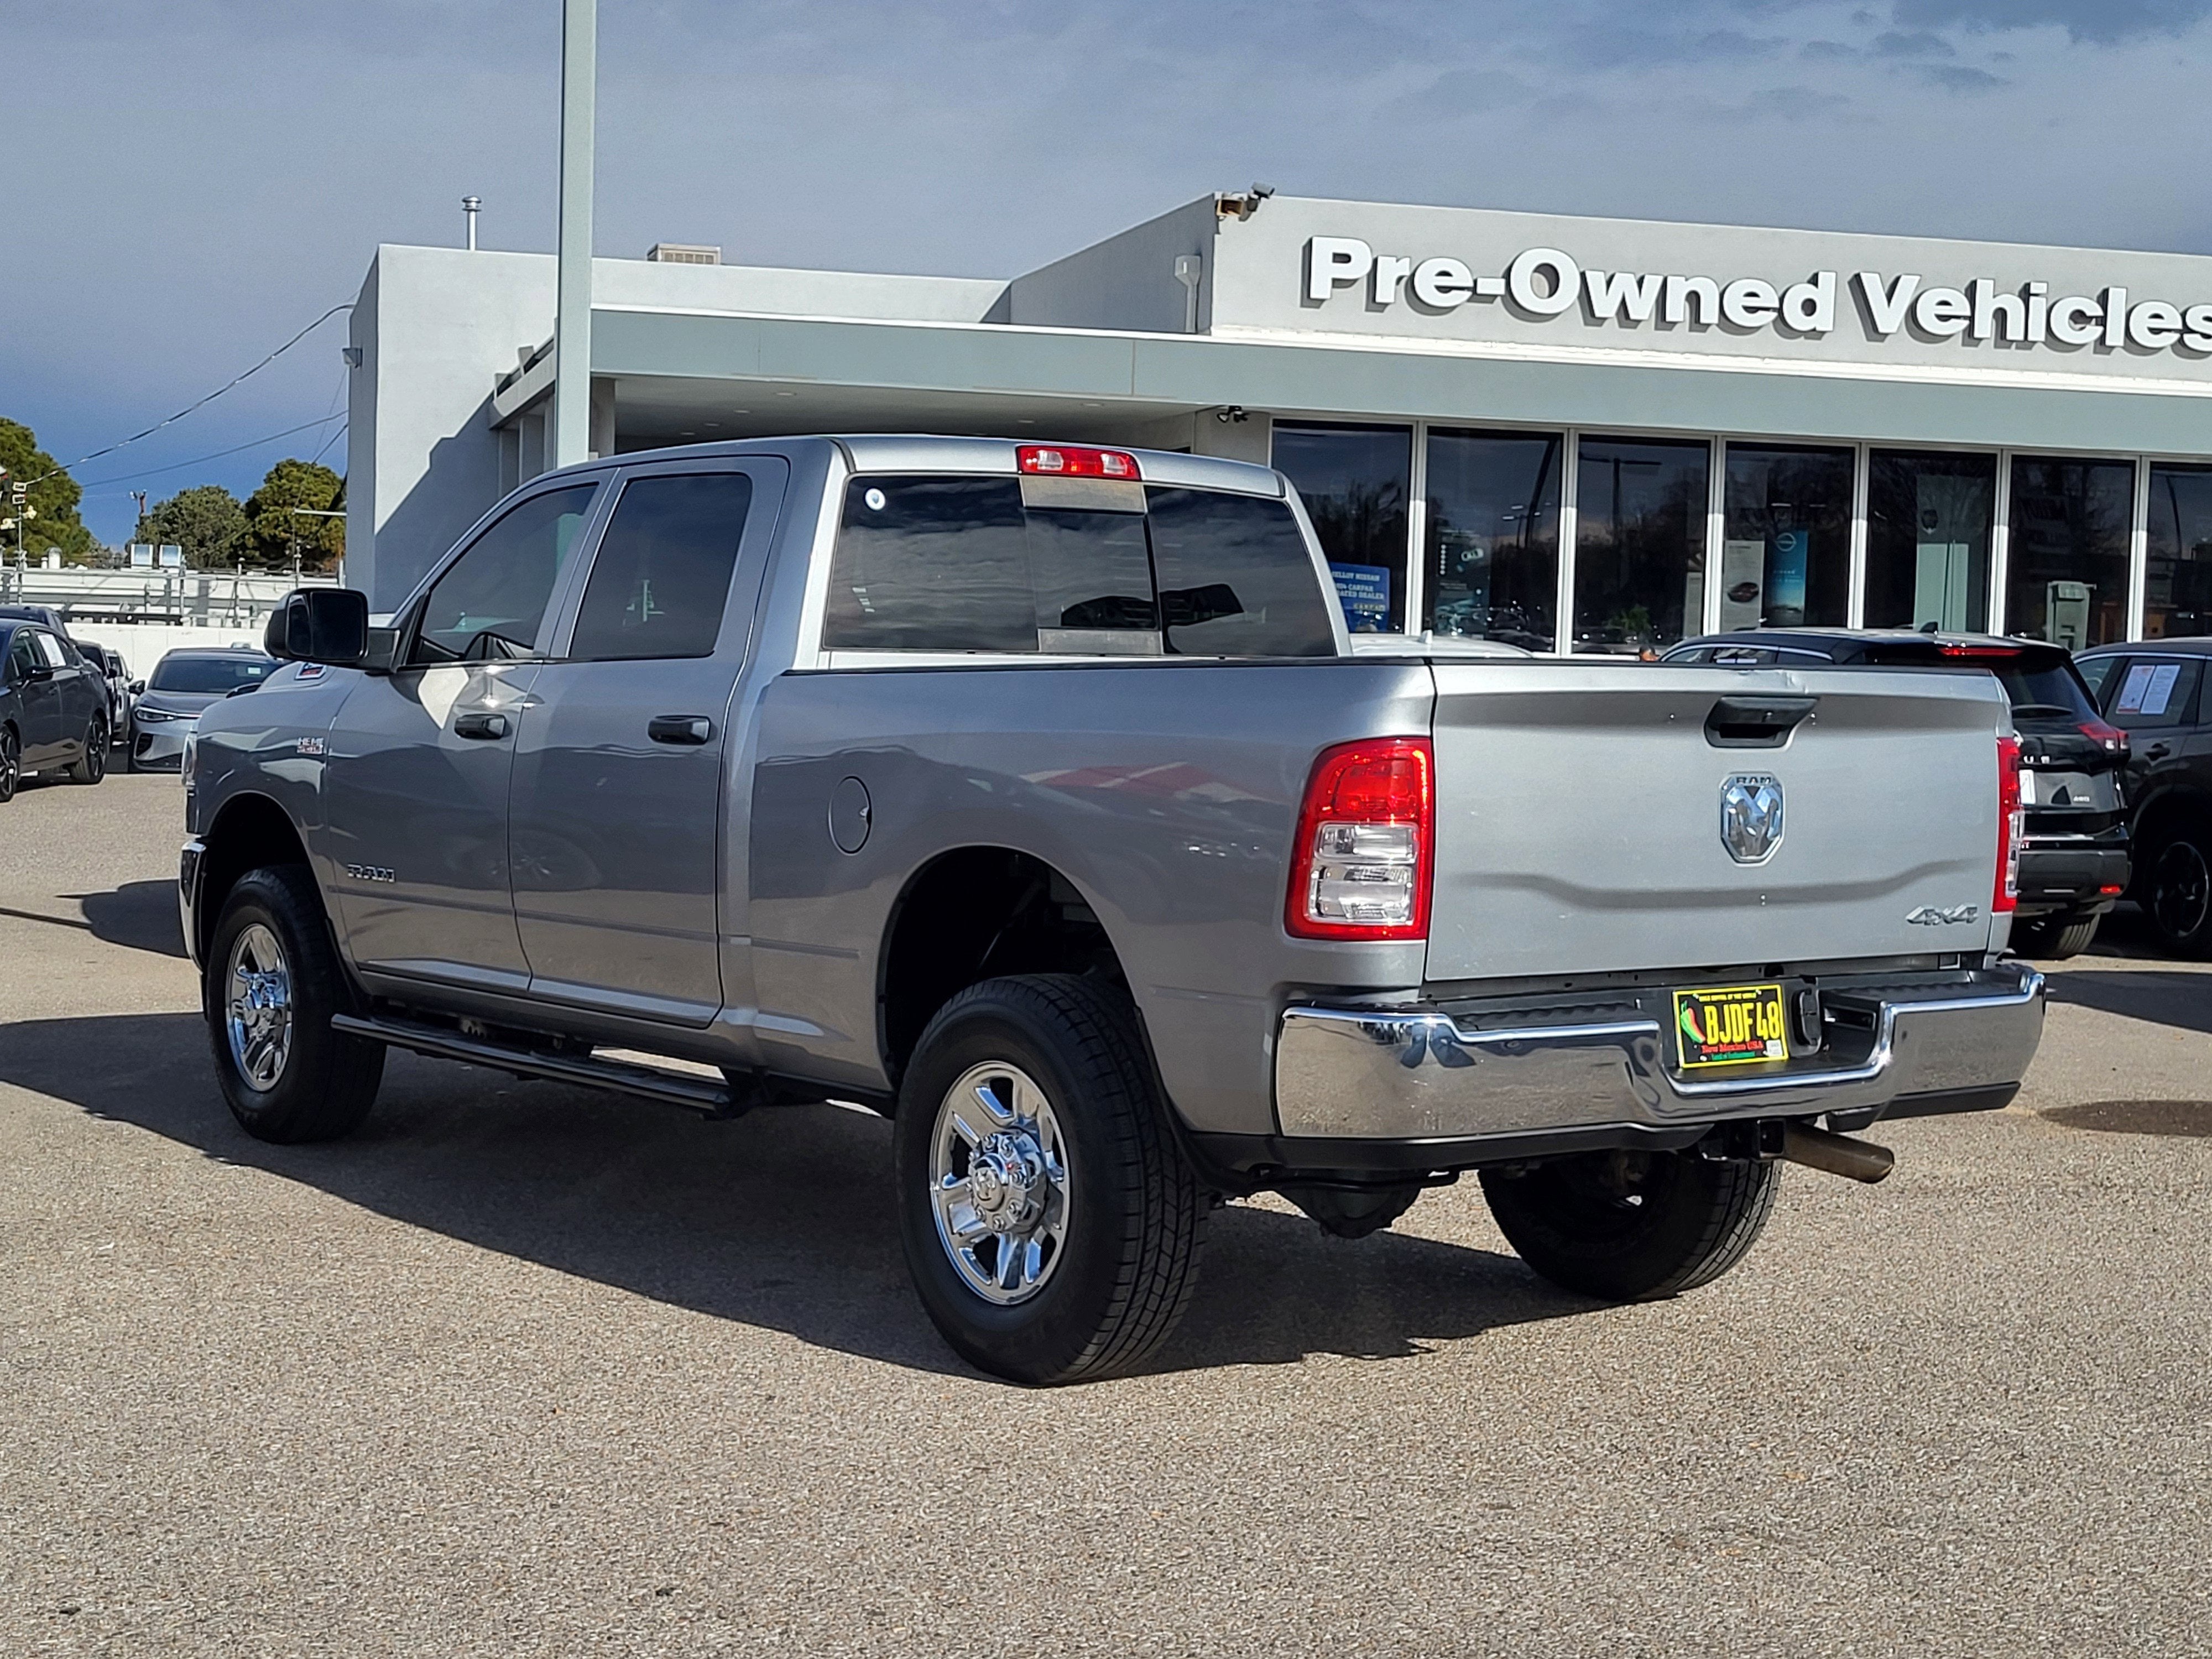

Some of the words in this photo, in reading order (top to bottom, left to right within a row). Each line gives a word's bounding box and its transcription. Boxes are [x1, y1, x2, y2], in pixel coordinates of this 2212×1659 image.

[1306, 236, 1838, 332] Pre-Owned
[1857, 271, 2212, 353] Vehicles
[1704, 1001, 1781, 1045] BJDF48
